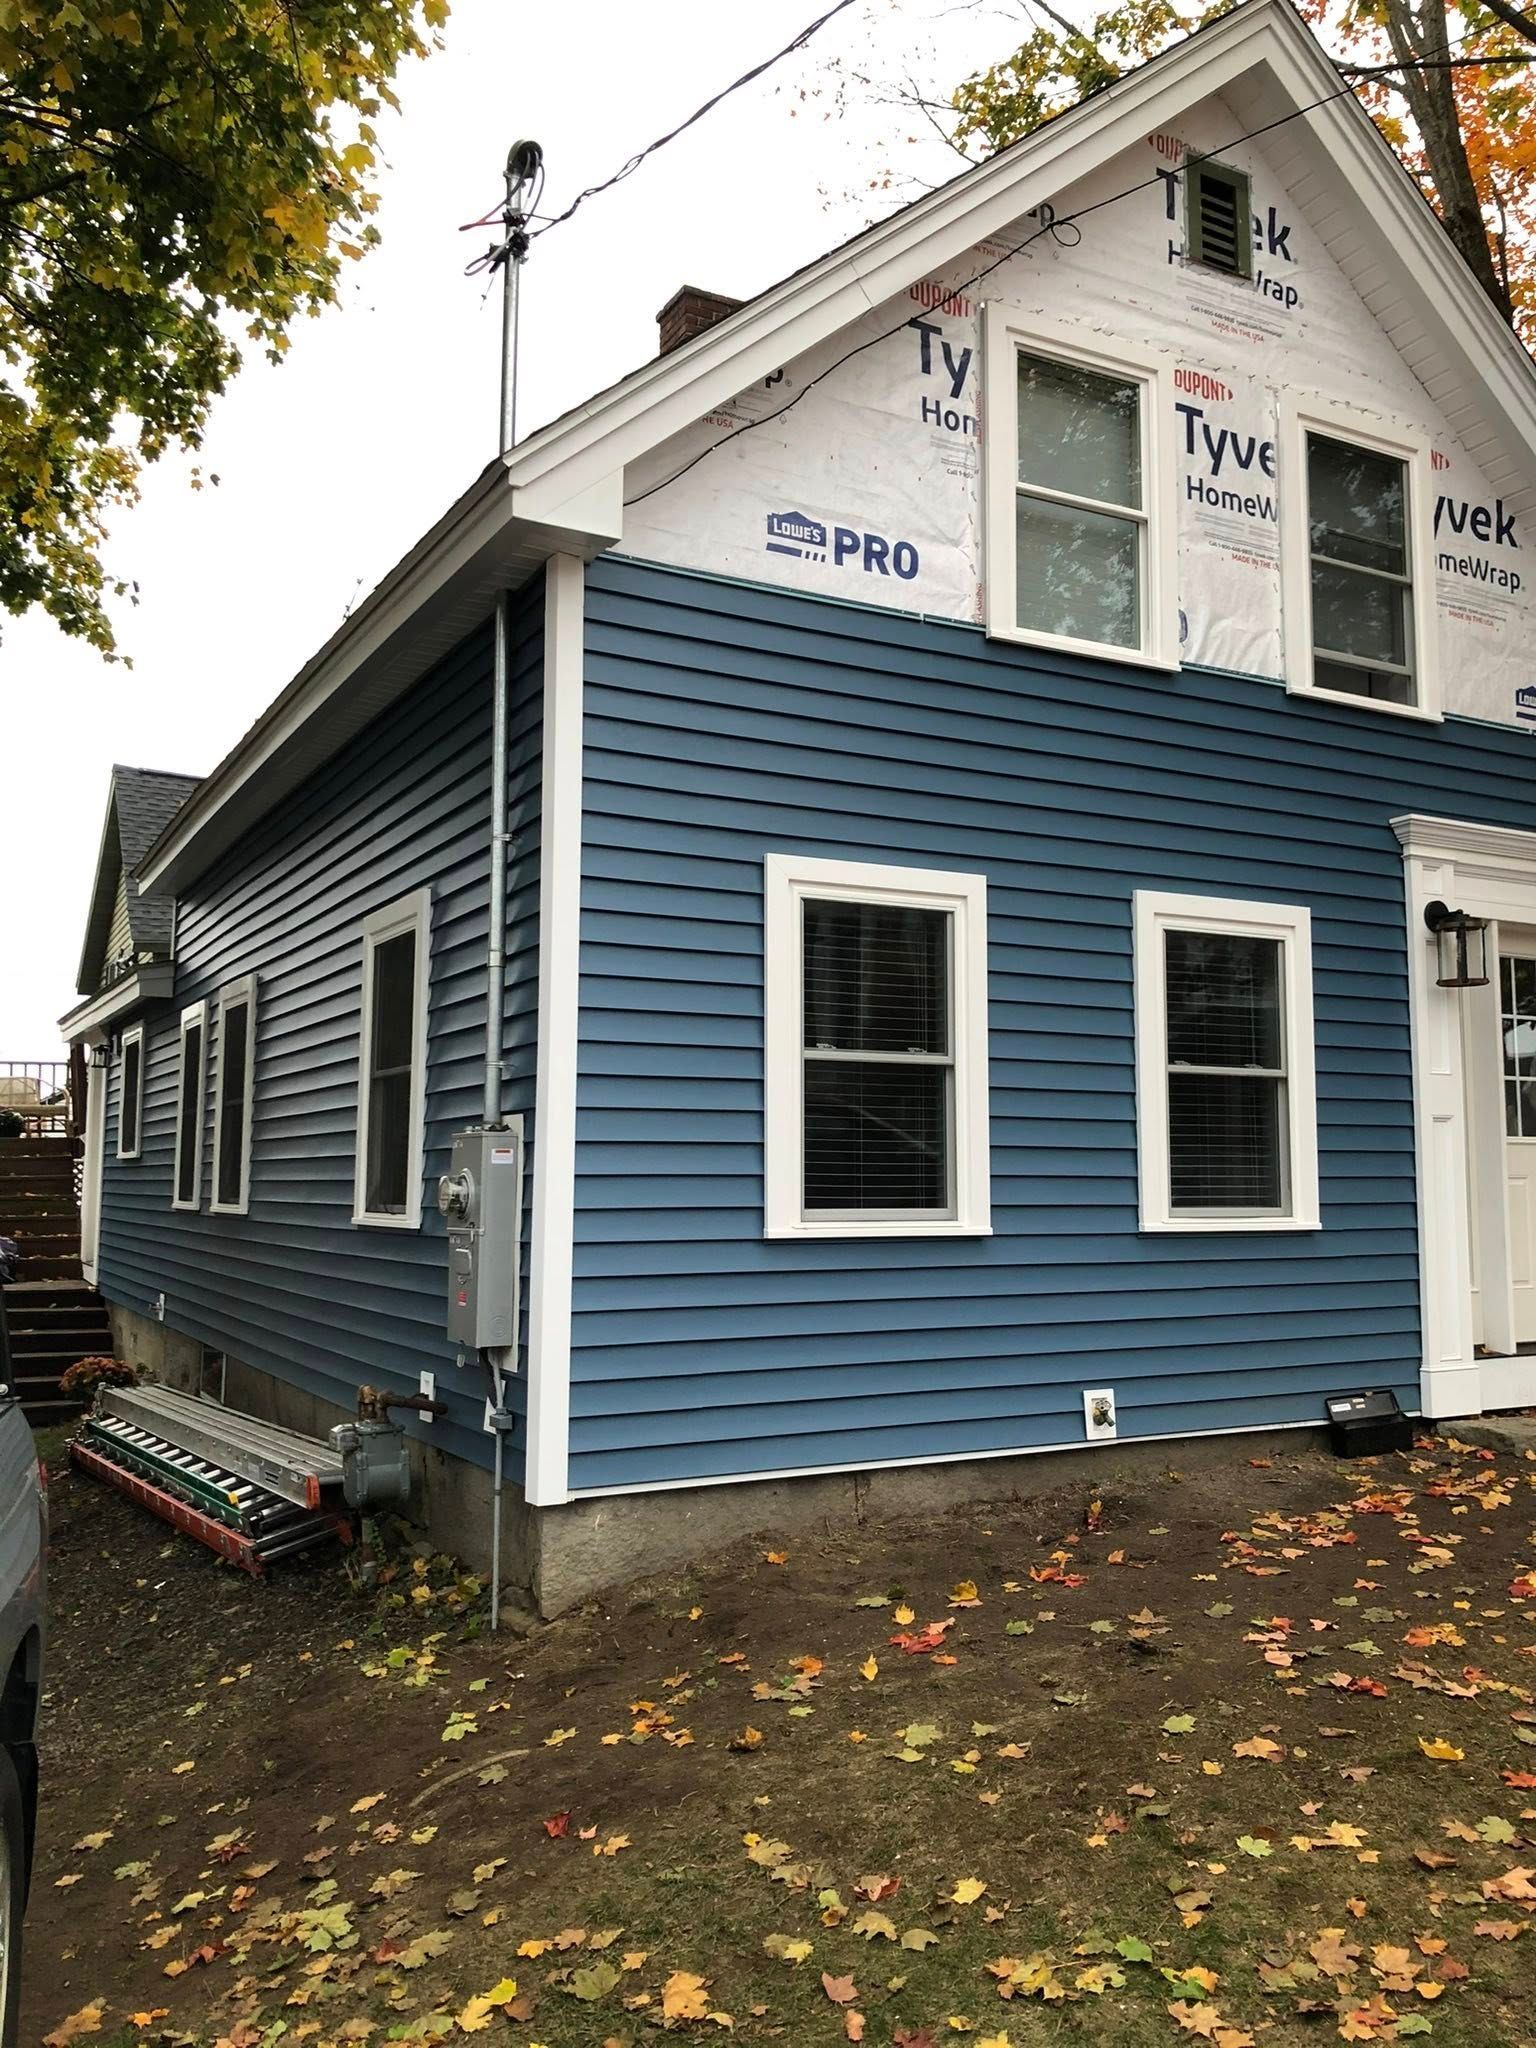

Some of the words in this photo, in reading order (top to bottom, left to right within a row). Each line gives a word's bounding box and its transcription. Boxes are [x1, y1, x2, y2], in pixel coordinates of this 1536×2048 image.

[910, 281, 971, 318] DUPONT
[1174, 369, 1226, 401] DUPONT
[717, 418, 734, 430] USA
[1186, 475, 1279, 523] HomeW
[834, 526, 919, 580] PRO
[1231, 554, 1250, 564] MADE
[1251, 558, 1259, 566] IN
[1259, 559, 1271, 569] THE
[1434, 553, 1520, 594] meWrap
